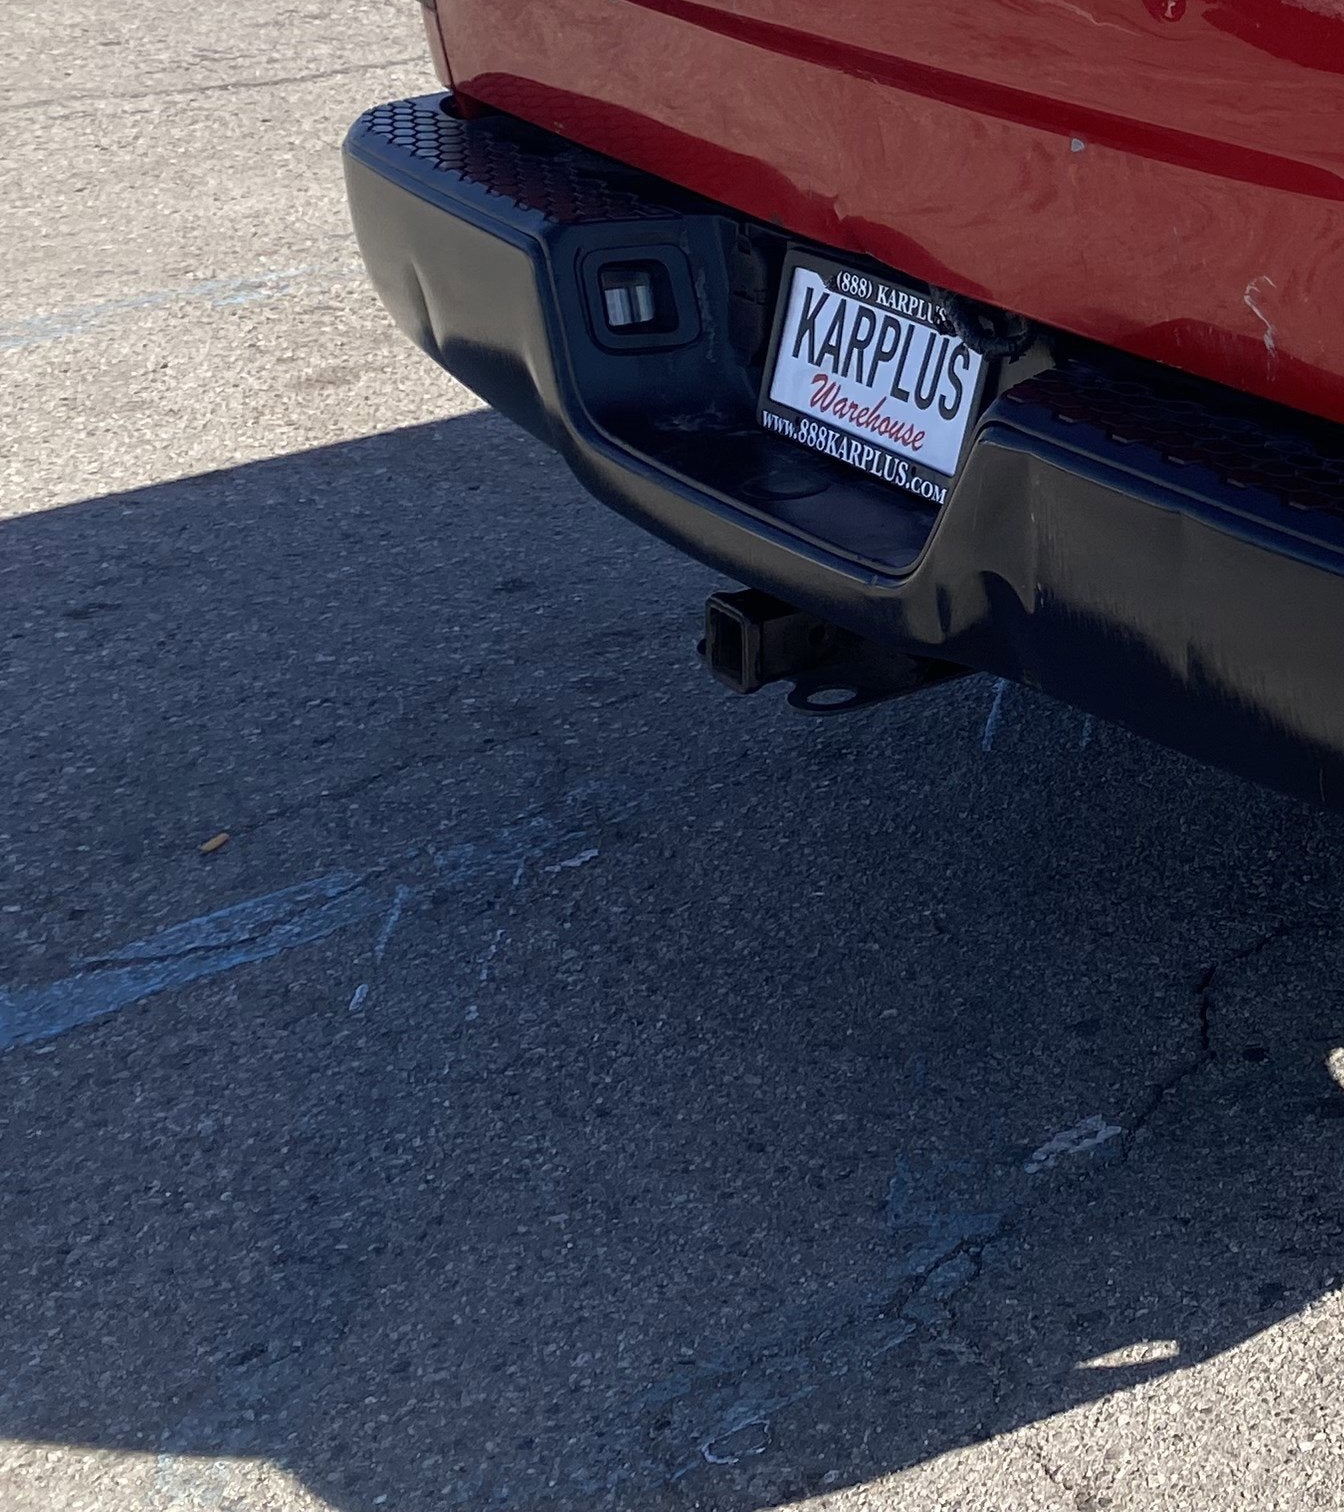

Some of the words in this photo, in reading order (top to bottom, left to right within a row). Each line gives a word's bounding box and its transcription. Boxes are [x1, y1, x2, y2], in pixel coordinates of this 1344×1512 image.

[836, 271, 873, 299] (888)
[792, 287, 971, 421] KARPLUS
[810, 374, 926, 451] Warehouse
